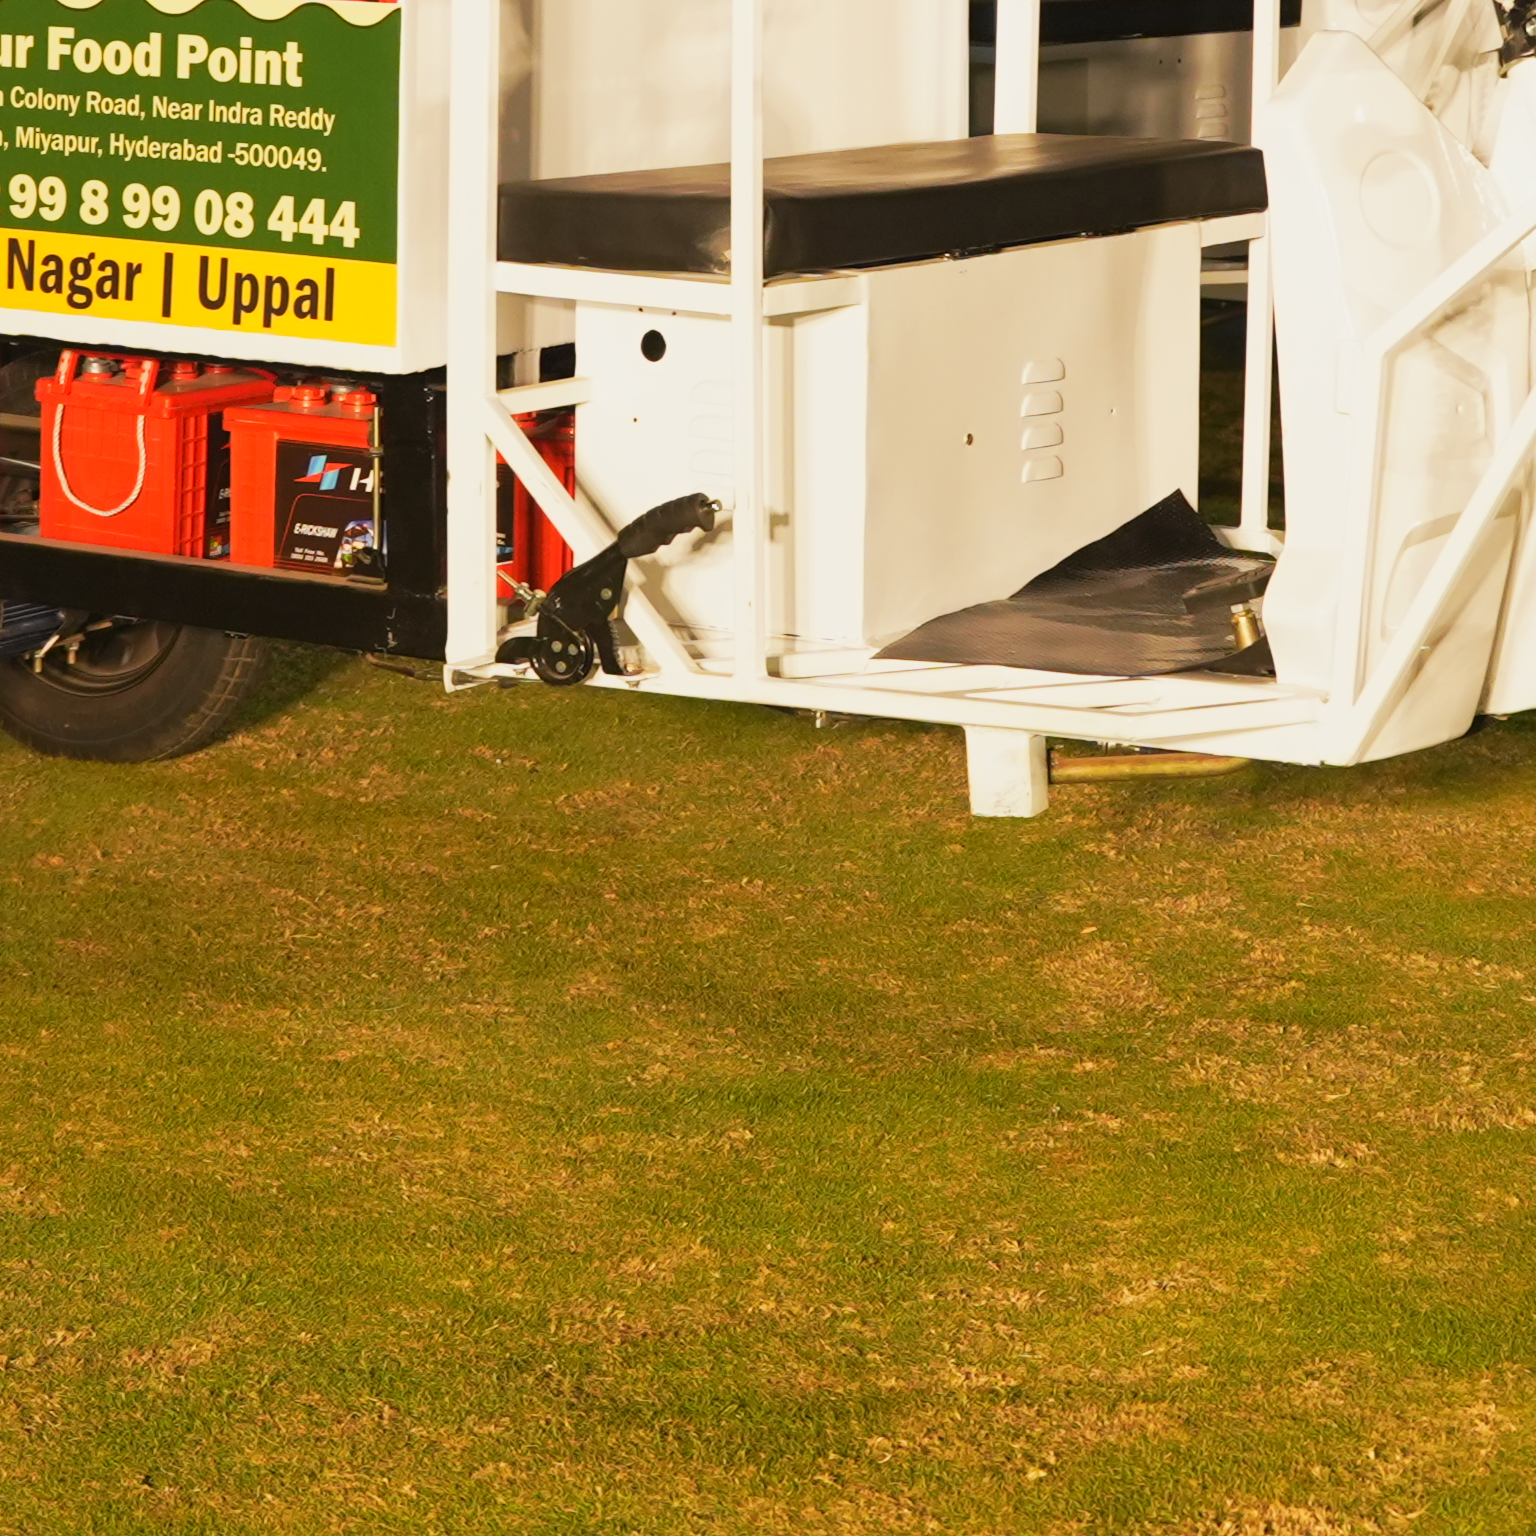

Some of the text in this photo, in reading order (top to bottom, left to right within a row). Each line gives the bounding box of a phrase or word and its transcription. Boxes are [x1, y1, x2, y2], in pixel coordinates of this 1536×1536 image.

[47, 25, 162, 78] Food
[176, 33, 304, 88] Point
[9, 85, 81, 117] Colony
[85, 90, 146, 121] Road,
[152, 95, 204, 121] Near
[208, 99, 263, 126] Indra
[269, 103, 336, 137] Reddy
[15, 125, 103, 158] Miyapur,
[109, 132, 223, 164] Hyderabad
[227, 142, 327, 173] -500049.
[8, 173, 68, 222] 99
[79, 179, 110, 226] 8
[121, 182, 181, 232] 99
[193, 188, 255, 239] 08
[267, 195, 361, 249] 444
[7, 237, 142, 310] Nagar
[198, 255, 335, 328] Uppal
